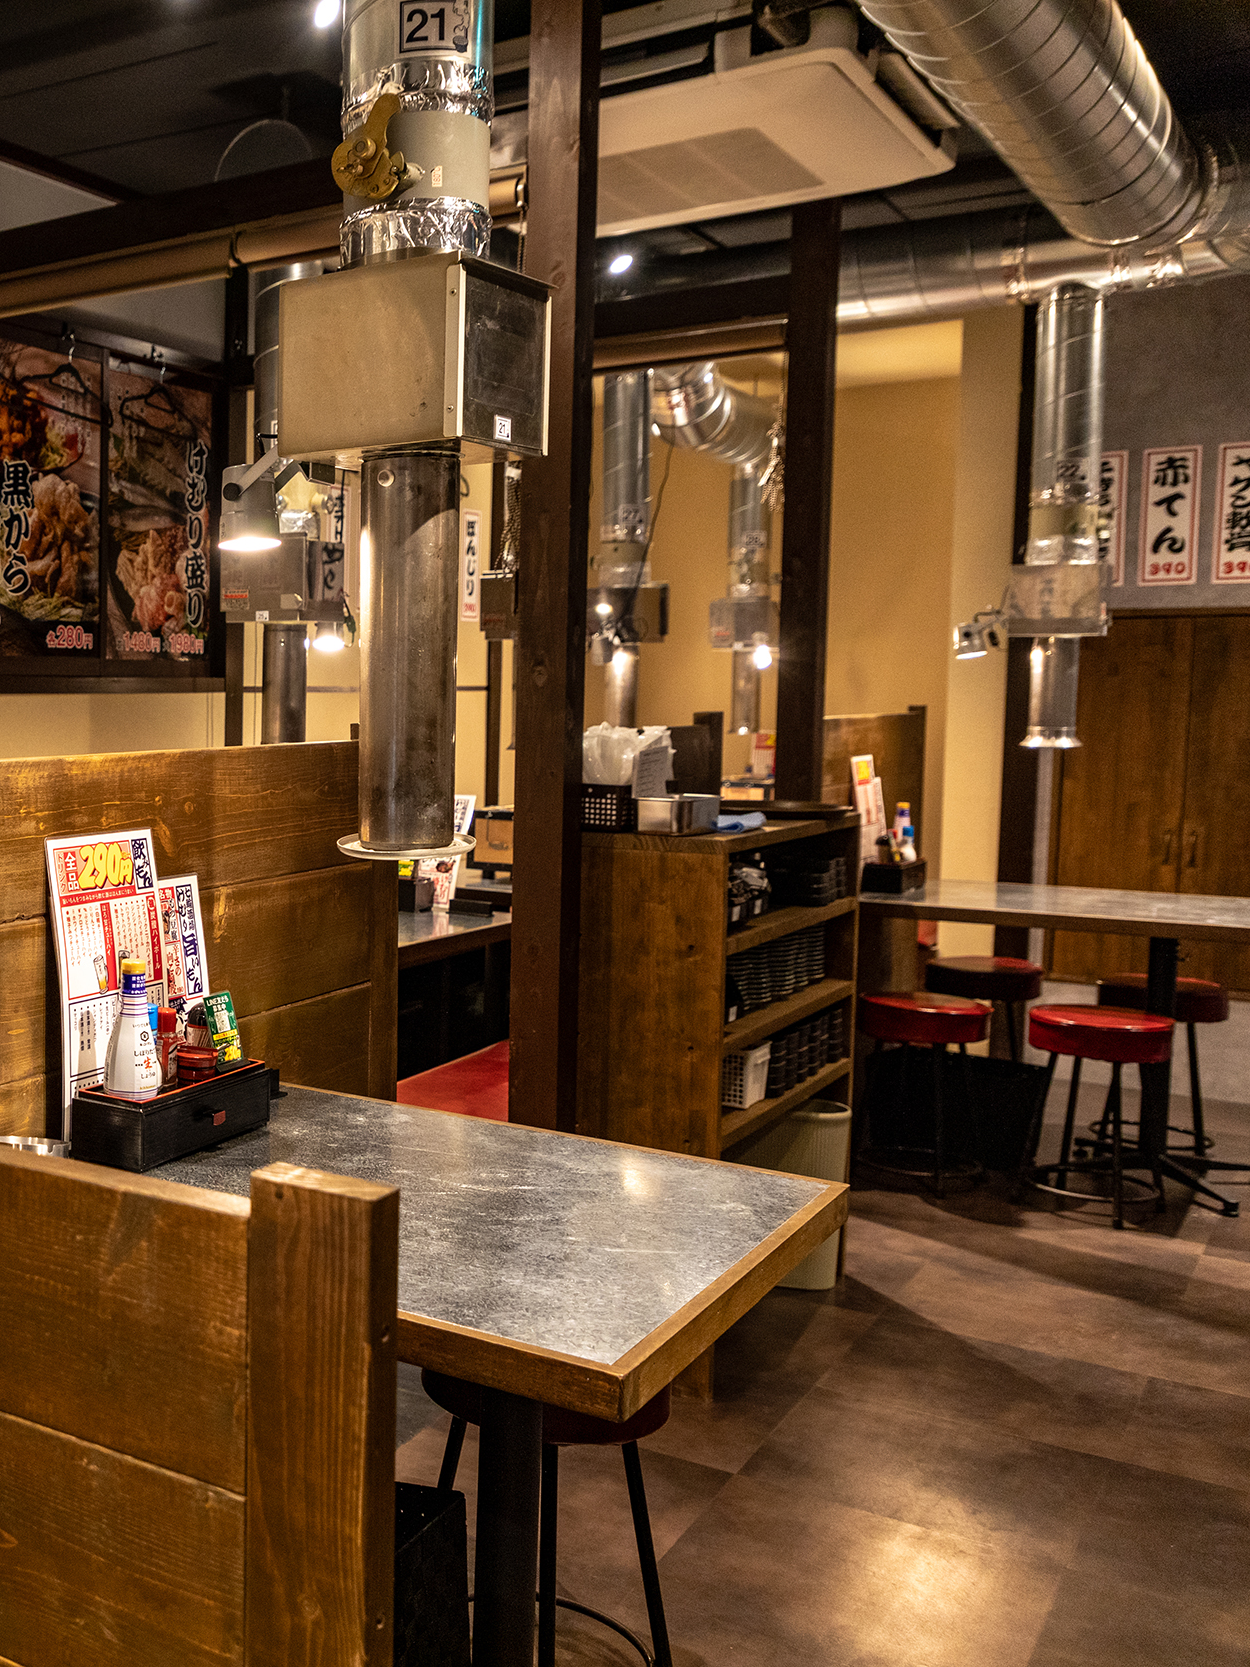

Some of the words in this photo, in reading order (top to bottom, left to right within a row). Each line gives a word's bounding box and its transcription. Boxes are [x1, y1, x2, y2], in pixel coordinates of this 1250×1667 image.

[405, 8, 447, 44] 21
[498, 422, 505, 434] 21
[1153, 456, 1190, 554] 赤てん
[1, 459, 33, 595] 黒から
[1150, 562, 1186, 576] 390
[1224, 561, 1250, 574] 39
[57, 853, 66, 893] ドリンク
[65, 852, 79, 891] 全品
[78, 842, 134, 890] 290円
[143, 1056, 153, 1070] 生
